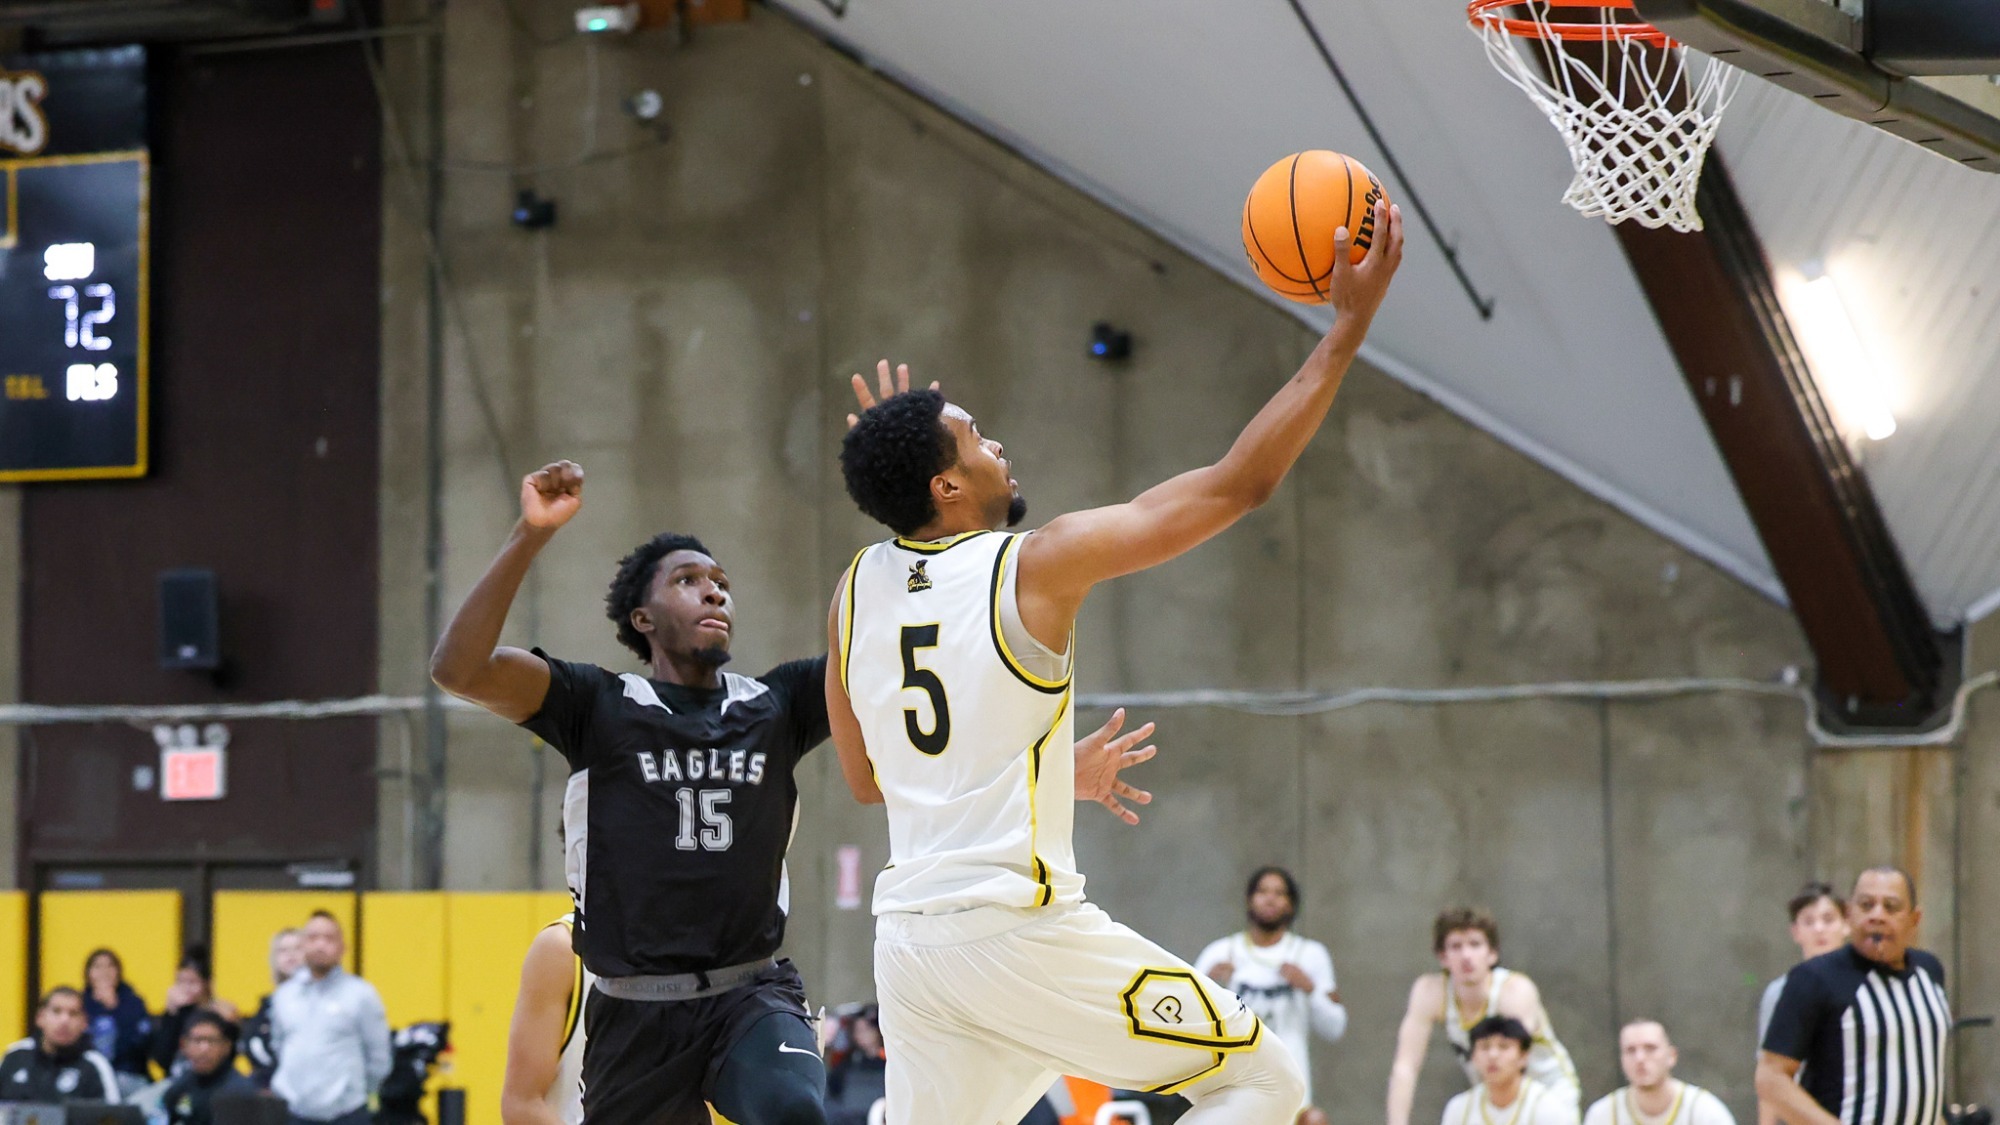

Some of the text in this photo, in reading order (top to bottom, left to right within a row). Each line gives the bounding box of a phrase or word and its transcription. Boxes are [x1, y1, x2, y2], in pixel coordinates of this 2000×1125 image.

[47, 283, 116, 350] 72
[900, 623, 950, 756] 5
[637, 748, 767, 785] EAGLES
[675, 787, 733, 851] 15
